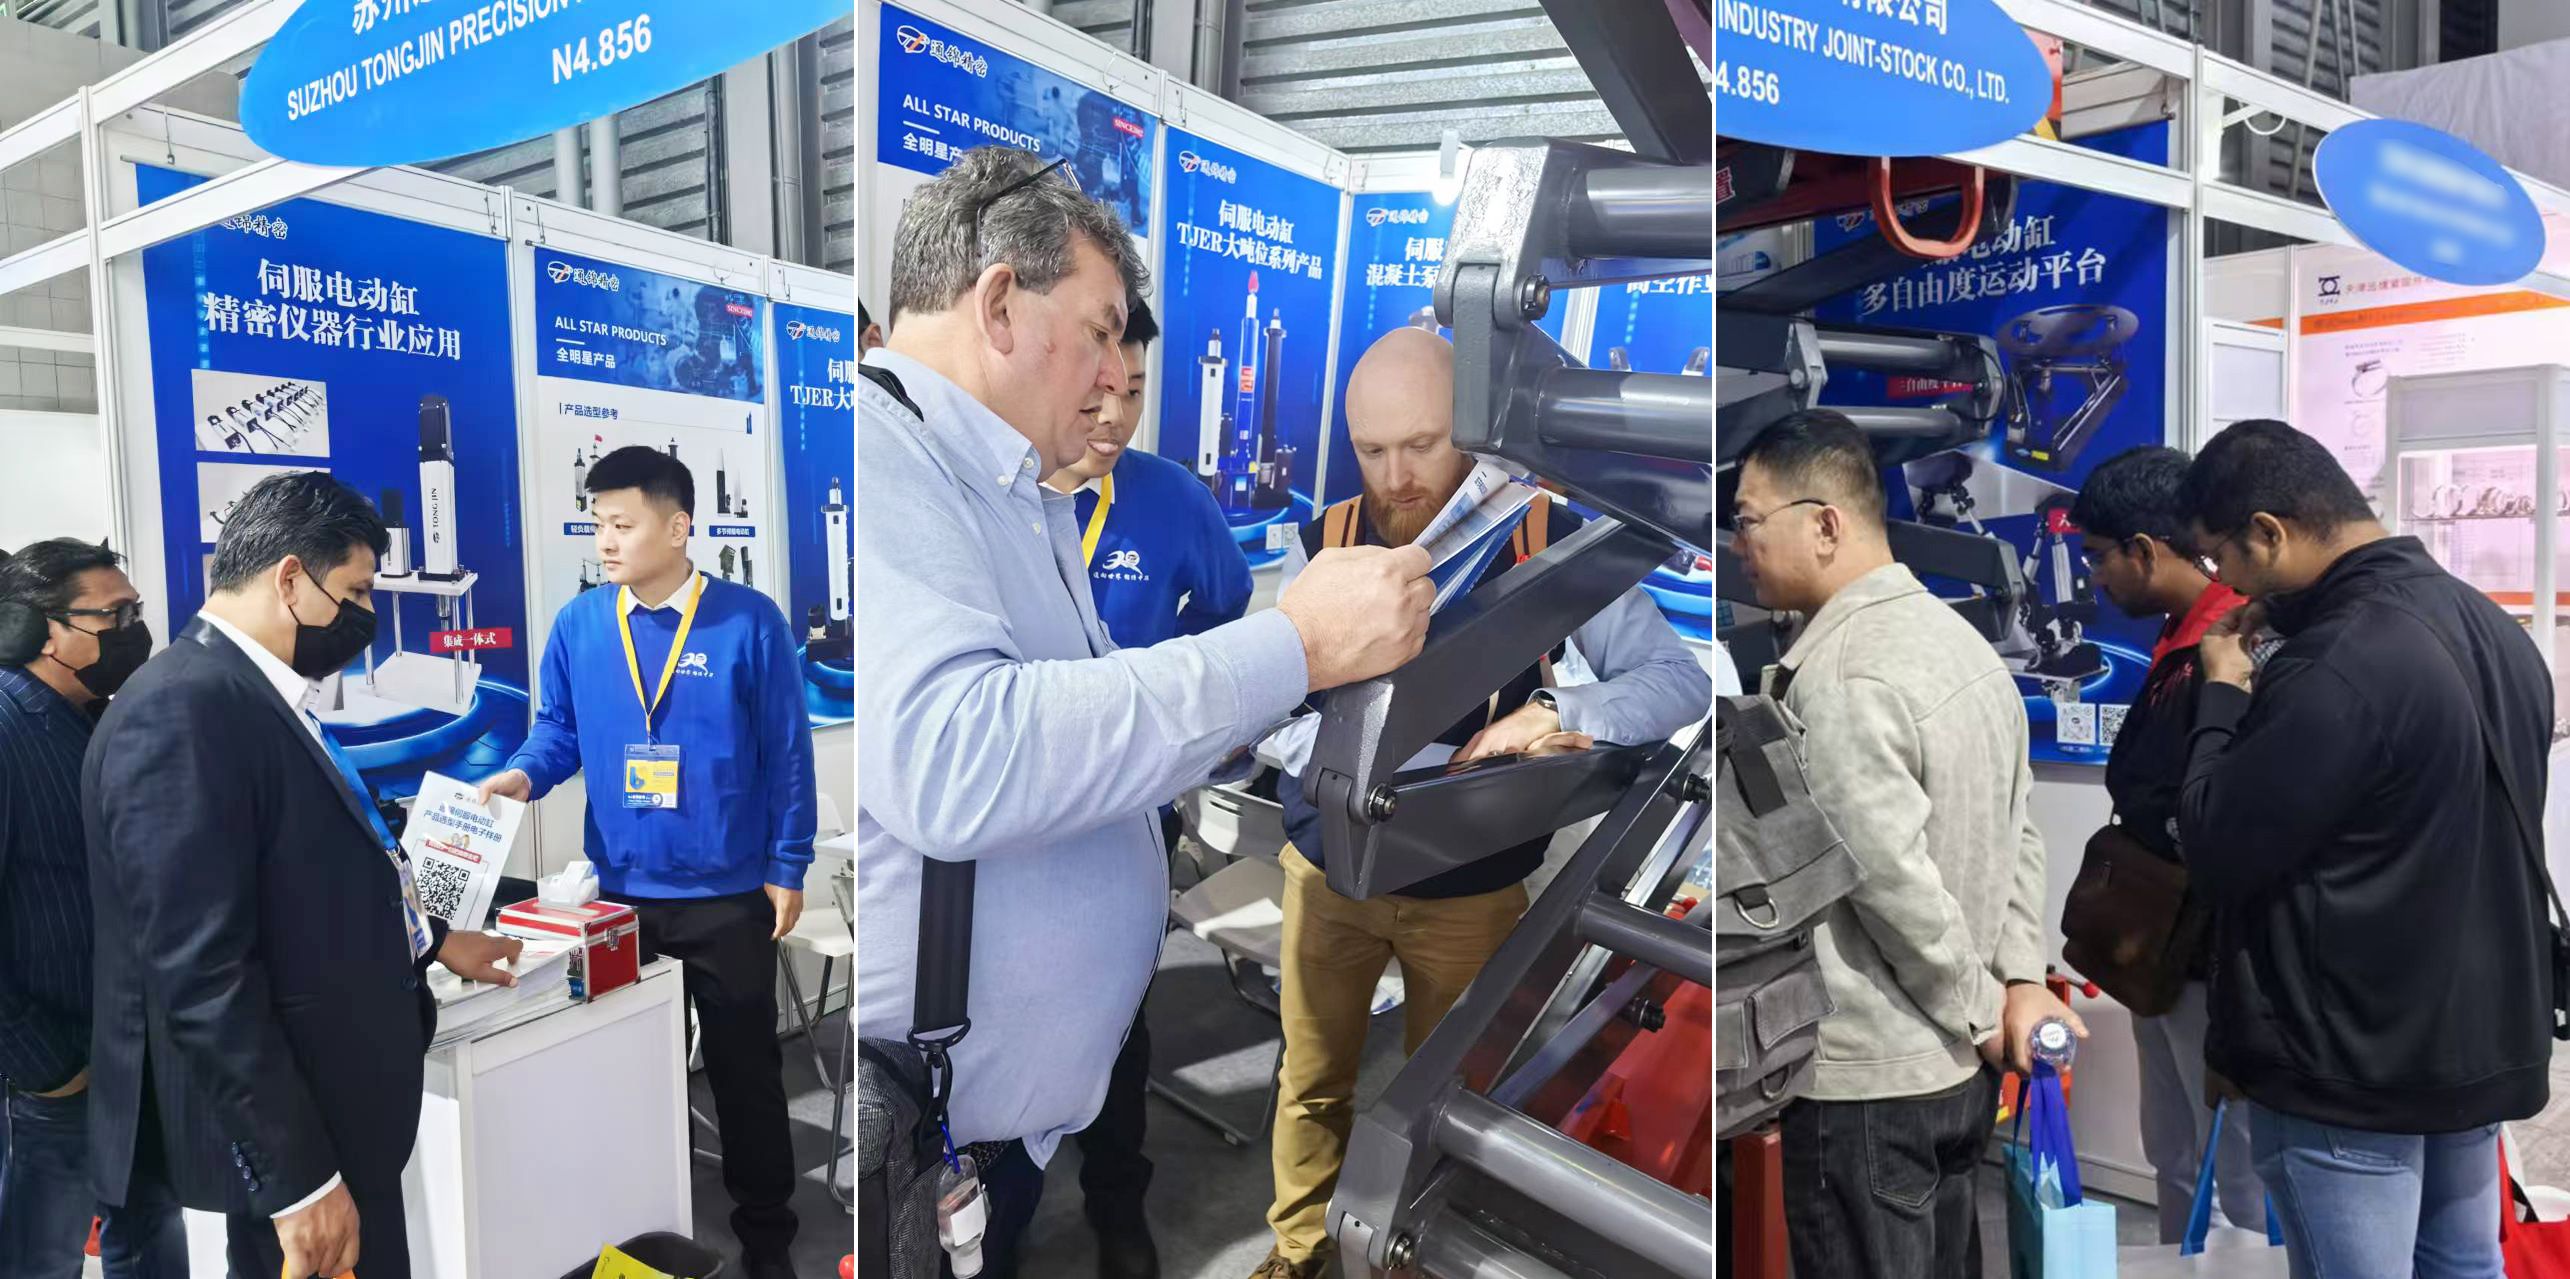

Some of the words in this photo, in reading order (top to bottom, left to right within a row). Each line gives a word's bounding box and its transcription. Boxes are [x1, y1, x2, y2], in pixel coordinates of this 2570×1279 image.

[287, 64, 358, 121] SUZHOU
[361, 27, 444, 90] TONGJIN
[552, 13, 652, 84] N4.856
[929, 40, 988, 78] 通锦精密
[1718, 0, 1819, 53] INDUSTRY
[1823, 27, 1938, 85] JOINT-STOCK
[1942, 60, 1974, 100] CO.,
[1977, 69, 2010, 104] LTD.
[903, 94, 930, 116] ALL
[934, 104, 970, 128] STAR
[974, 117, 1041, 153] PRODUCTS
[1177, 221, 1323, 280] TJER大吨位系列产品
[1218, 199, 1295, 244] 伺服电动缸
[1405, 236, 1448, 262] 伺服
[257, 258, 420, 316] 伺服电动缸
[1861, 247, 2107, 316] 多自由度运动平台
[202, 291, 460, 361] 精密仪器行业应用
[555, 316, 577, 332] ALL
[579, 320, 608, 336] STAR
[611, 325, 667, 346] PRODUCTS
[556, 347, 616, 369] 全明星产品
[564, 404, 618, 420] 产品选型参考
[790, 384, 854, 411] TJER大
